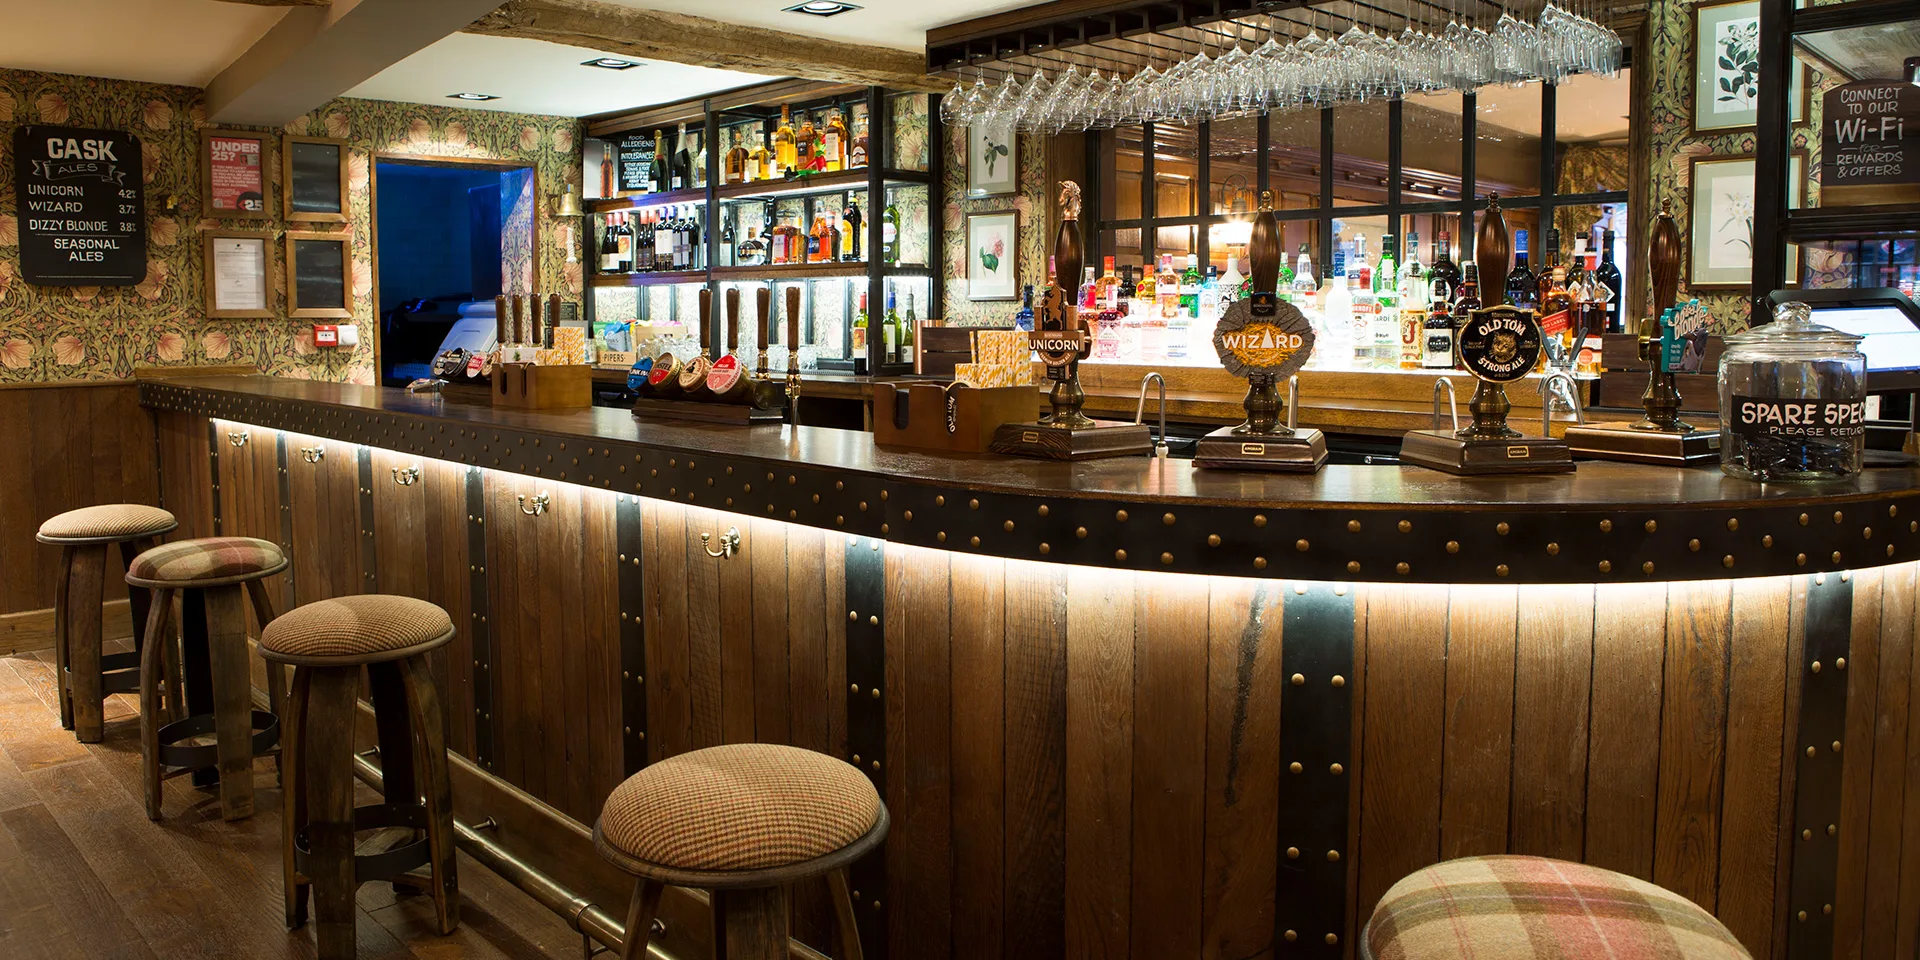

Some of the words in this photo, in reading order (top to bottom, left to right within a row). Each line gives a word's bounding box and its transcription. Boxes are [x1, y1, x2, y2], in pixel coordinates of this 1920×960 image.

[1840, 87, 1902, 103] CONNECT
[1847, 103, 1862, 115] TO
[1868, 101, 1899, 114] OUR
[1835, 116, 1904, 144] Wi-Fi
[47, 137, 118, 162] CASK
[211, 141, 260, 153] UNDER
[212, 151, 236, 161] 25?
[1836, 151, 1904, 166] REWARDS
[57, 163, 98, 175] ALES
[1837, 166, 1849, 179] &
[1850, 164, 1902, 177] OFFERS
[28, 184, 84, 196] UNICORN
[28, 201, 83, 213] WIZARD
[29, 219, 64, 231] DIZZY
[66, 220, 108, 232] BLONDE
[54, 238, 120, 250] SEASONAL
[69, 251, 104, 262] ALES
[1478, 318, 1502, 336] OLD
[1502, 318, 1527, 336] TOM
[1028, 339, 1079, 351] UNICORN
[1221, 328, 1303, 349] WIZARD
[603, 353, 625, 363] PIPERS
[1477, 355, 1511, 372] STRONG
[1510, 356, 1526, 370] ALE
[1741, 402, 1817, 426] SPARE
